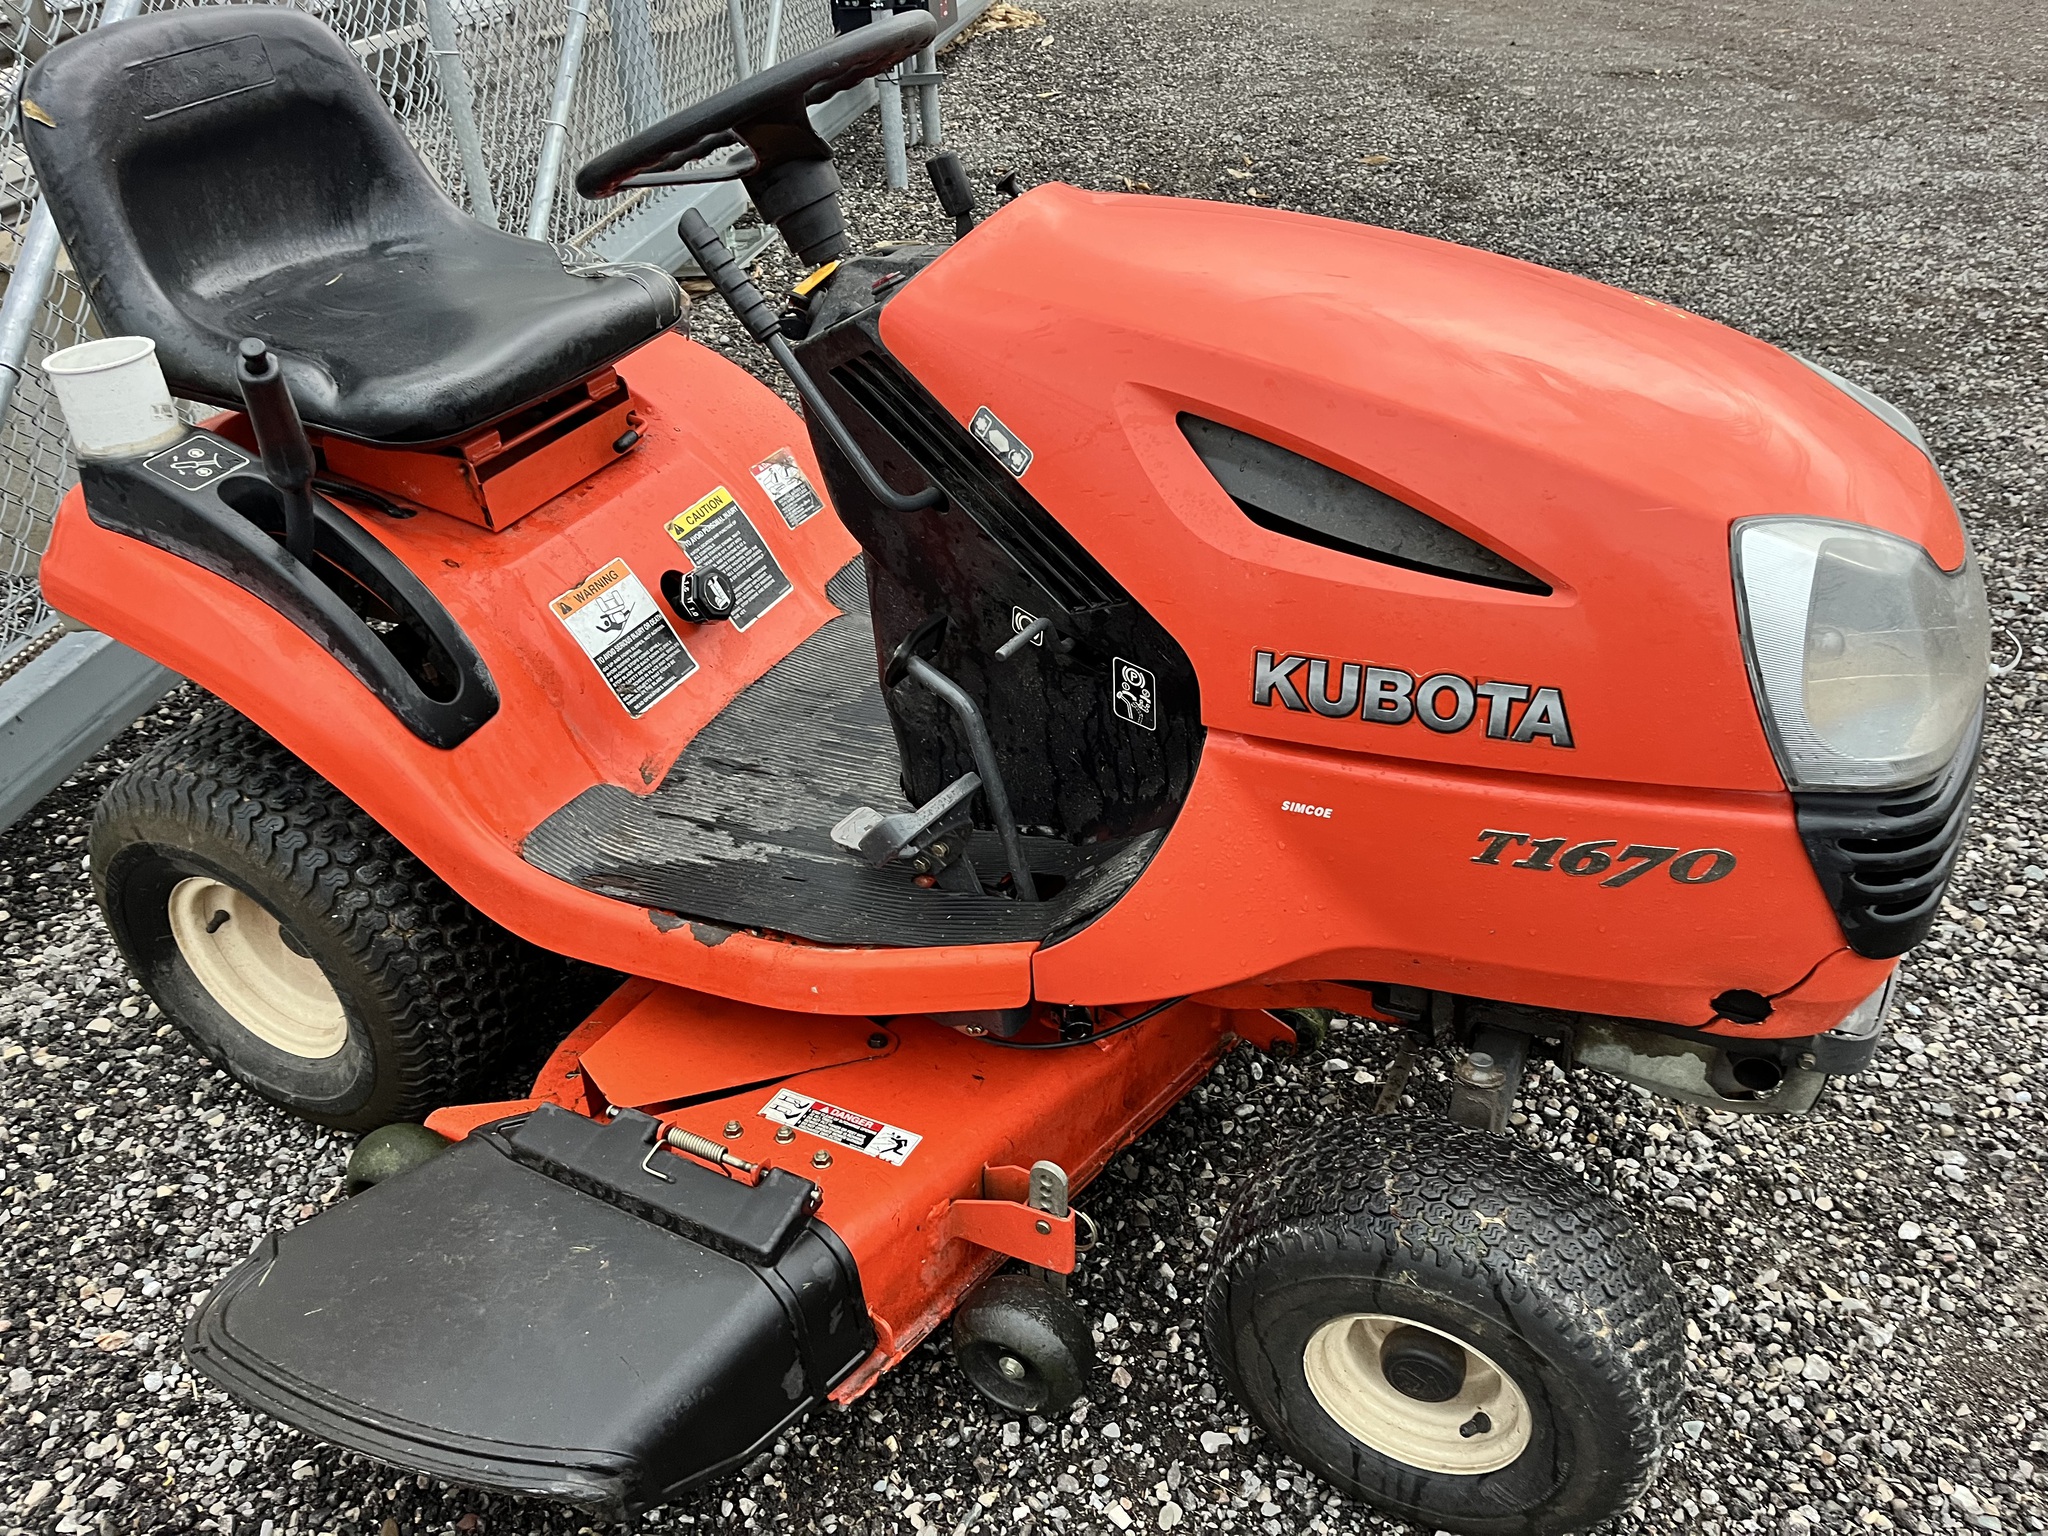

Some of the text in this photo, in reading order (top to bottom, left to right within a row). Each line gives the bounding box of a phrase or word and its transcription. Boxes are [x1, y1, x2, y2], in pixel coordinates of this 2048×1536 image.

[686, 495, 723, 525] CAUTION
[689, 530, 704, 544] AVOID
[574, 570, 619, 604] WARNING
[597, 656, 606, 665] TO
[602, 648, 617, 661] AVOID
[614, 636, 633, 652] SERIOUS
[630, 626, 646, 640] INJURY
[643, 622, 652, 631] OR
[1252, 650, 1575, 748] KUBOTA
[1281, 800, 1333, 818] SIMCOE
[1470, 829, 1737, 888] T1670
[830, 1108, 874, 1128] DANGER
